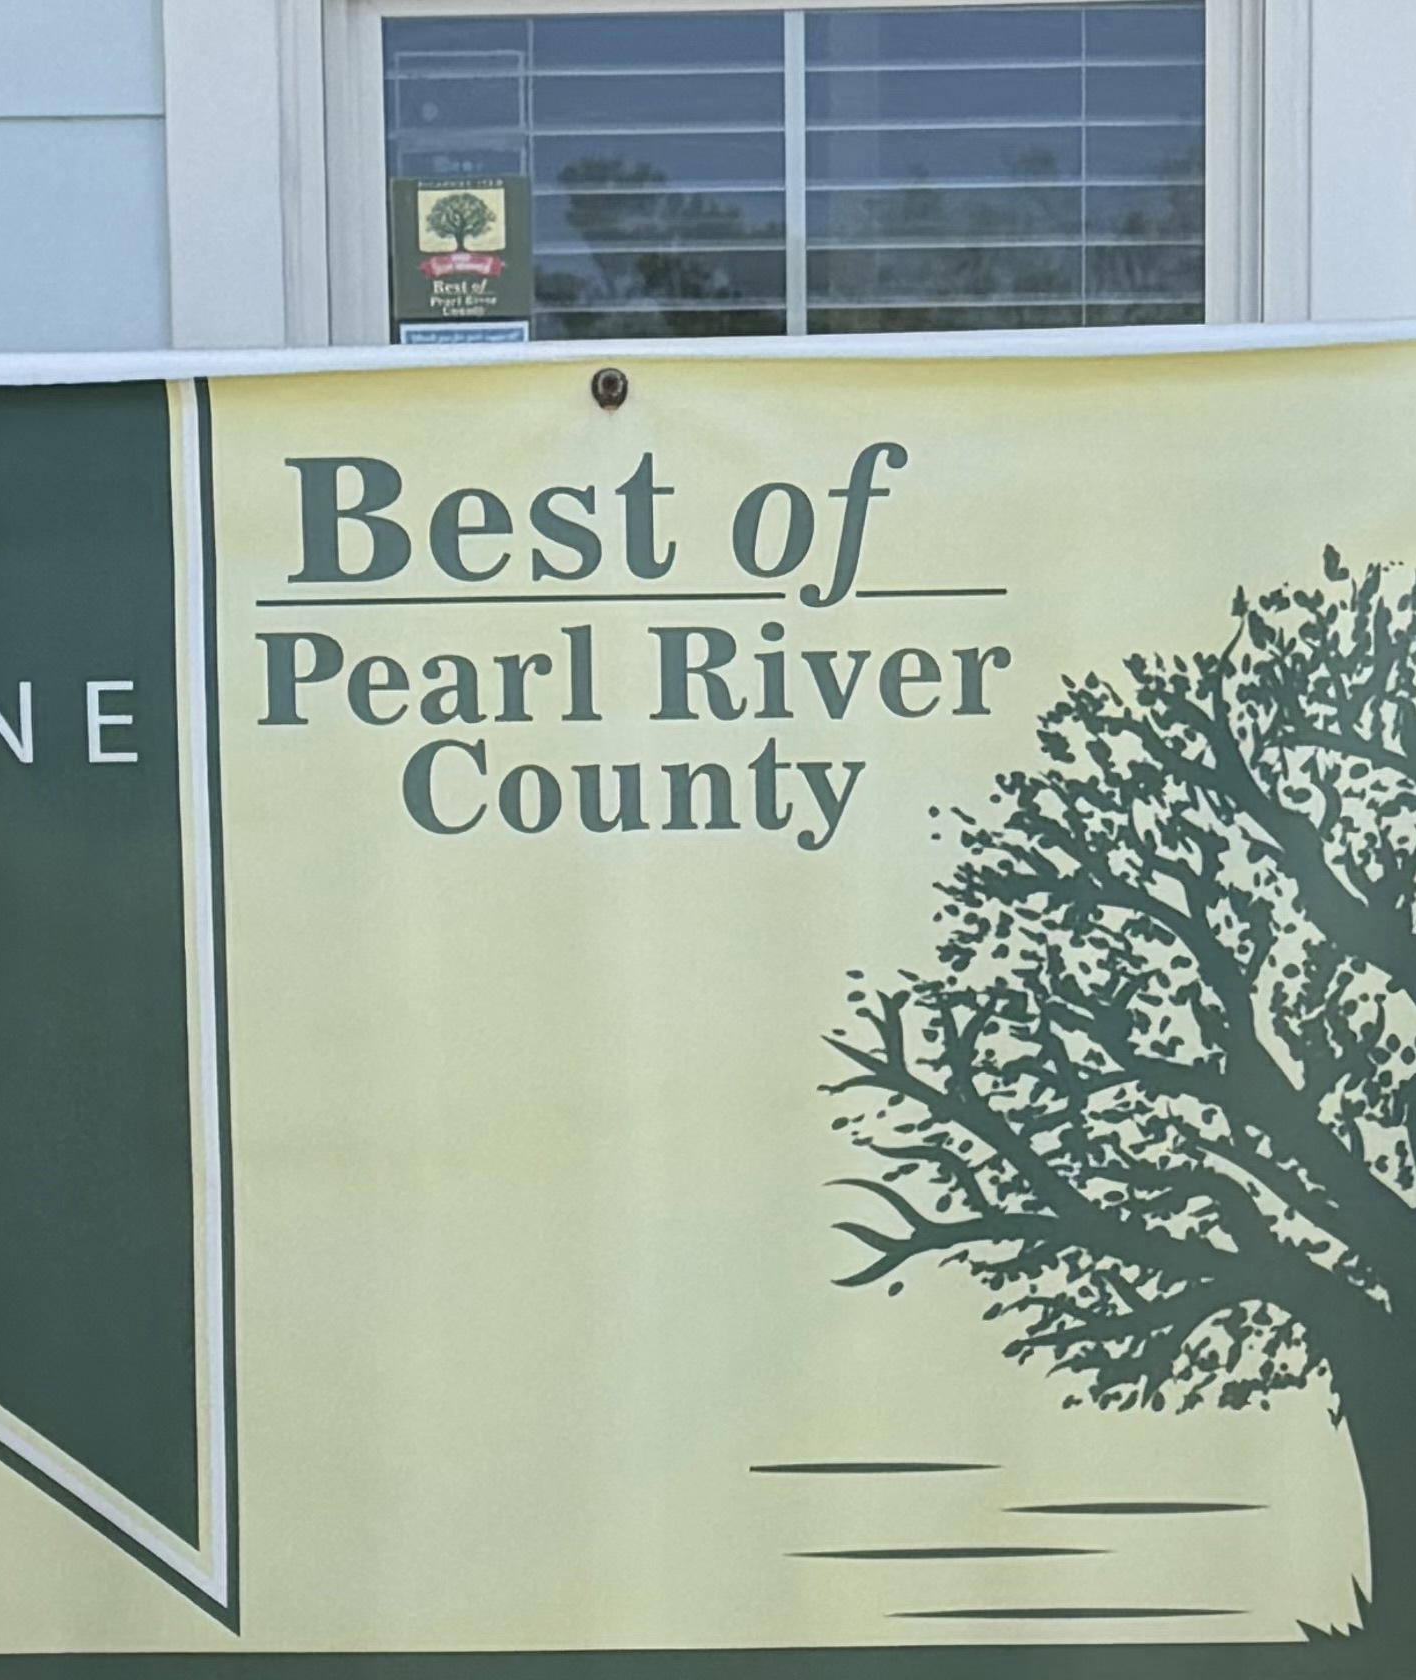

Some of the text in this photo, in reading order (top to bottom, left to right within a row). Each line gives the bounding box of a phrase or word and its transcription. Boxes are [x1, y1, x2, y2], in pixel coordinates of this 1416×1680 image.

[284, 442, 908, 609] Best of
[255, 621, 1012, 726] Pearl River
[401, 735, 866, 851] County
